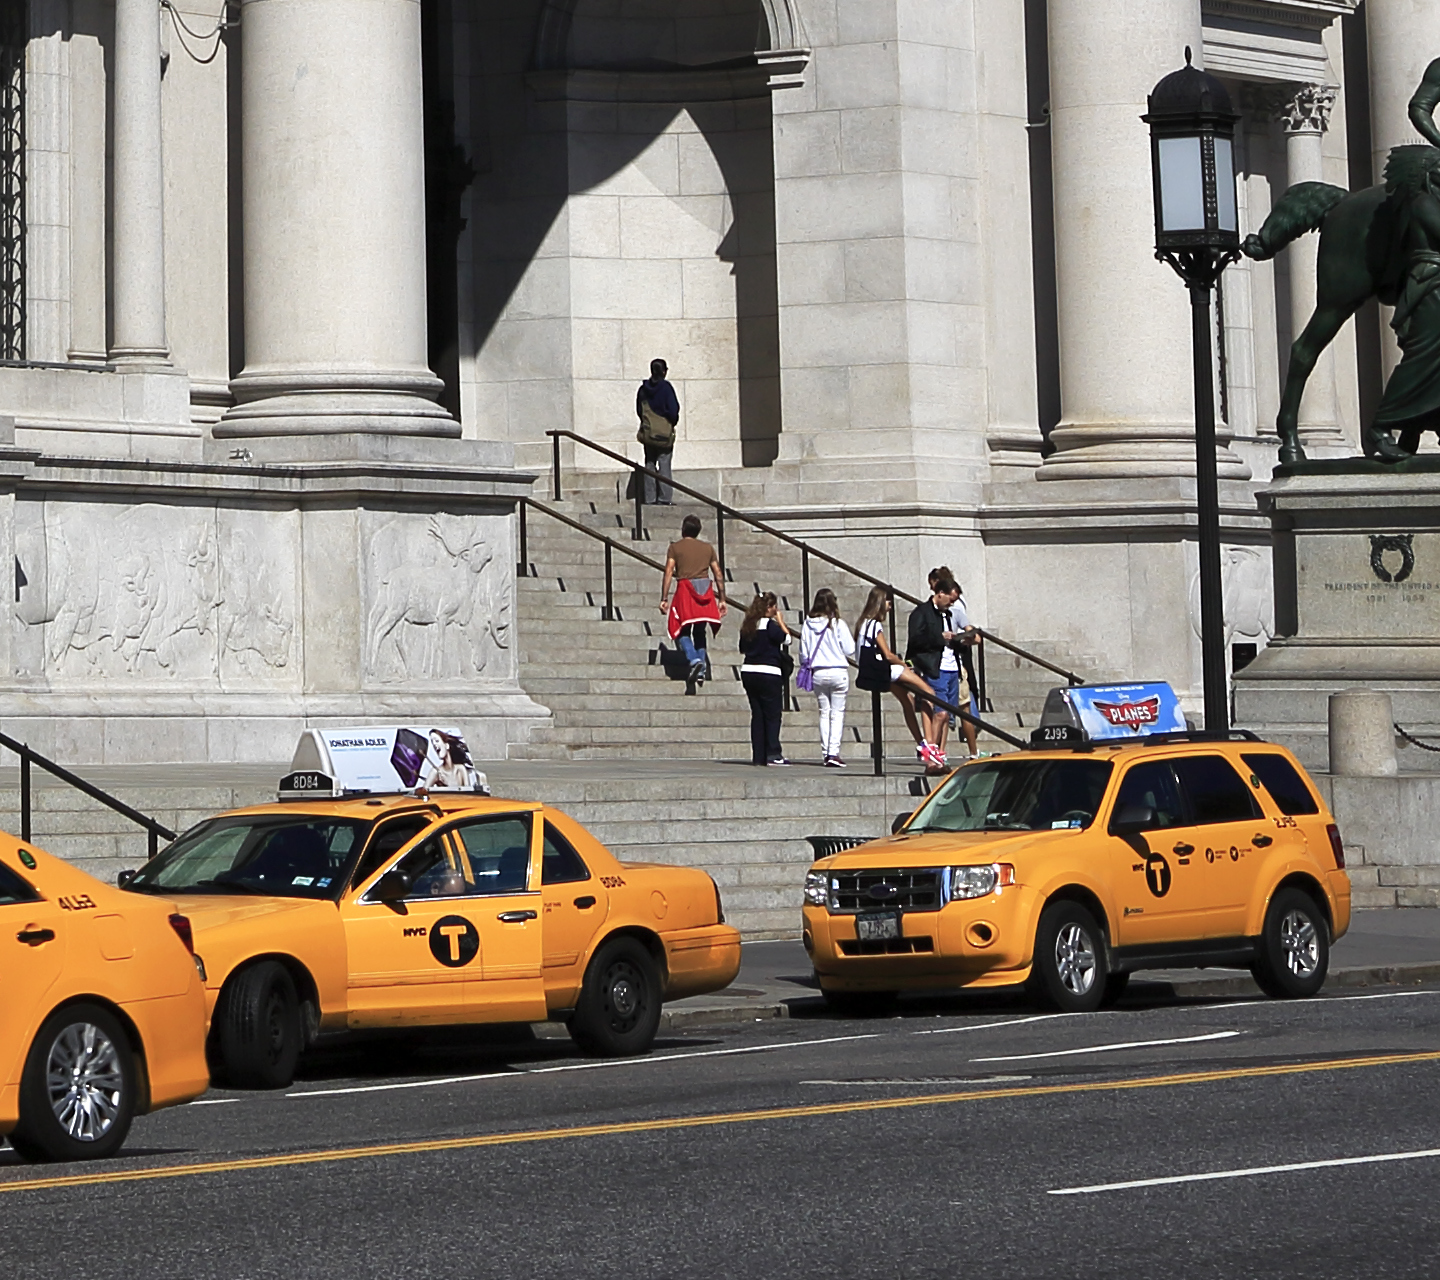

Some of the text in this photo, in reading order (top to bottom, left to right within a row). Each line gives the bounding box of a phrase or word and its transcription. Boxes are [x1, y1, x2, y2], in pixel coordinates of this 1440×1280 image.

[1109, 705, 1152, 722] PLANES
[1044, 727, 1068, 740] 2J95
[293, 775, 319, 789] 8D84
[1149, 861, 1165, 892] T
[58, 894, 97, 912] 4L63
[403, 925, 467, 961] NYC T
